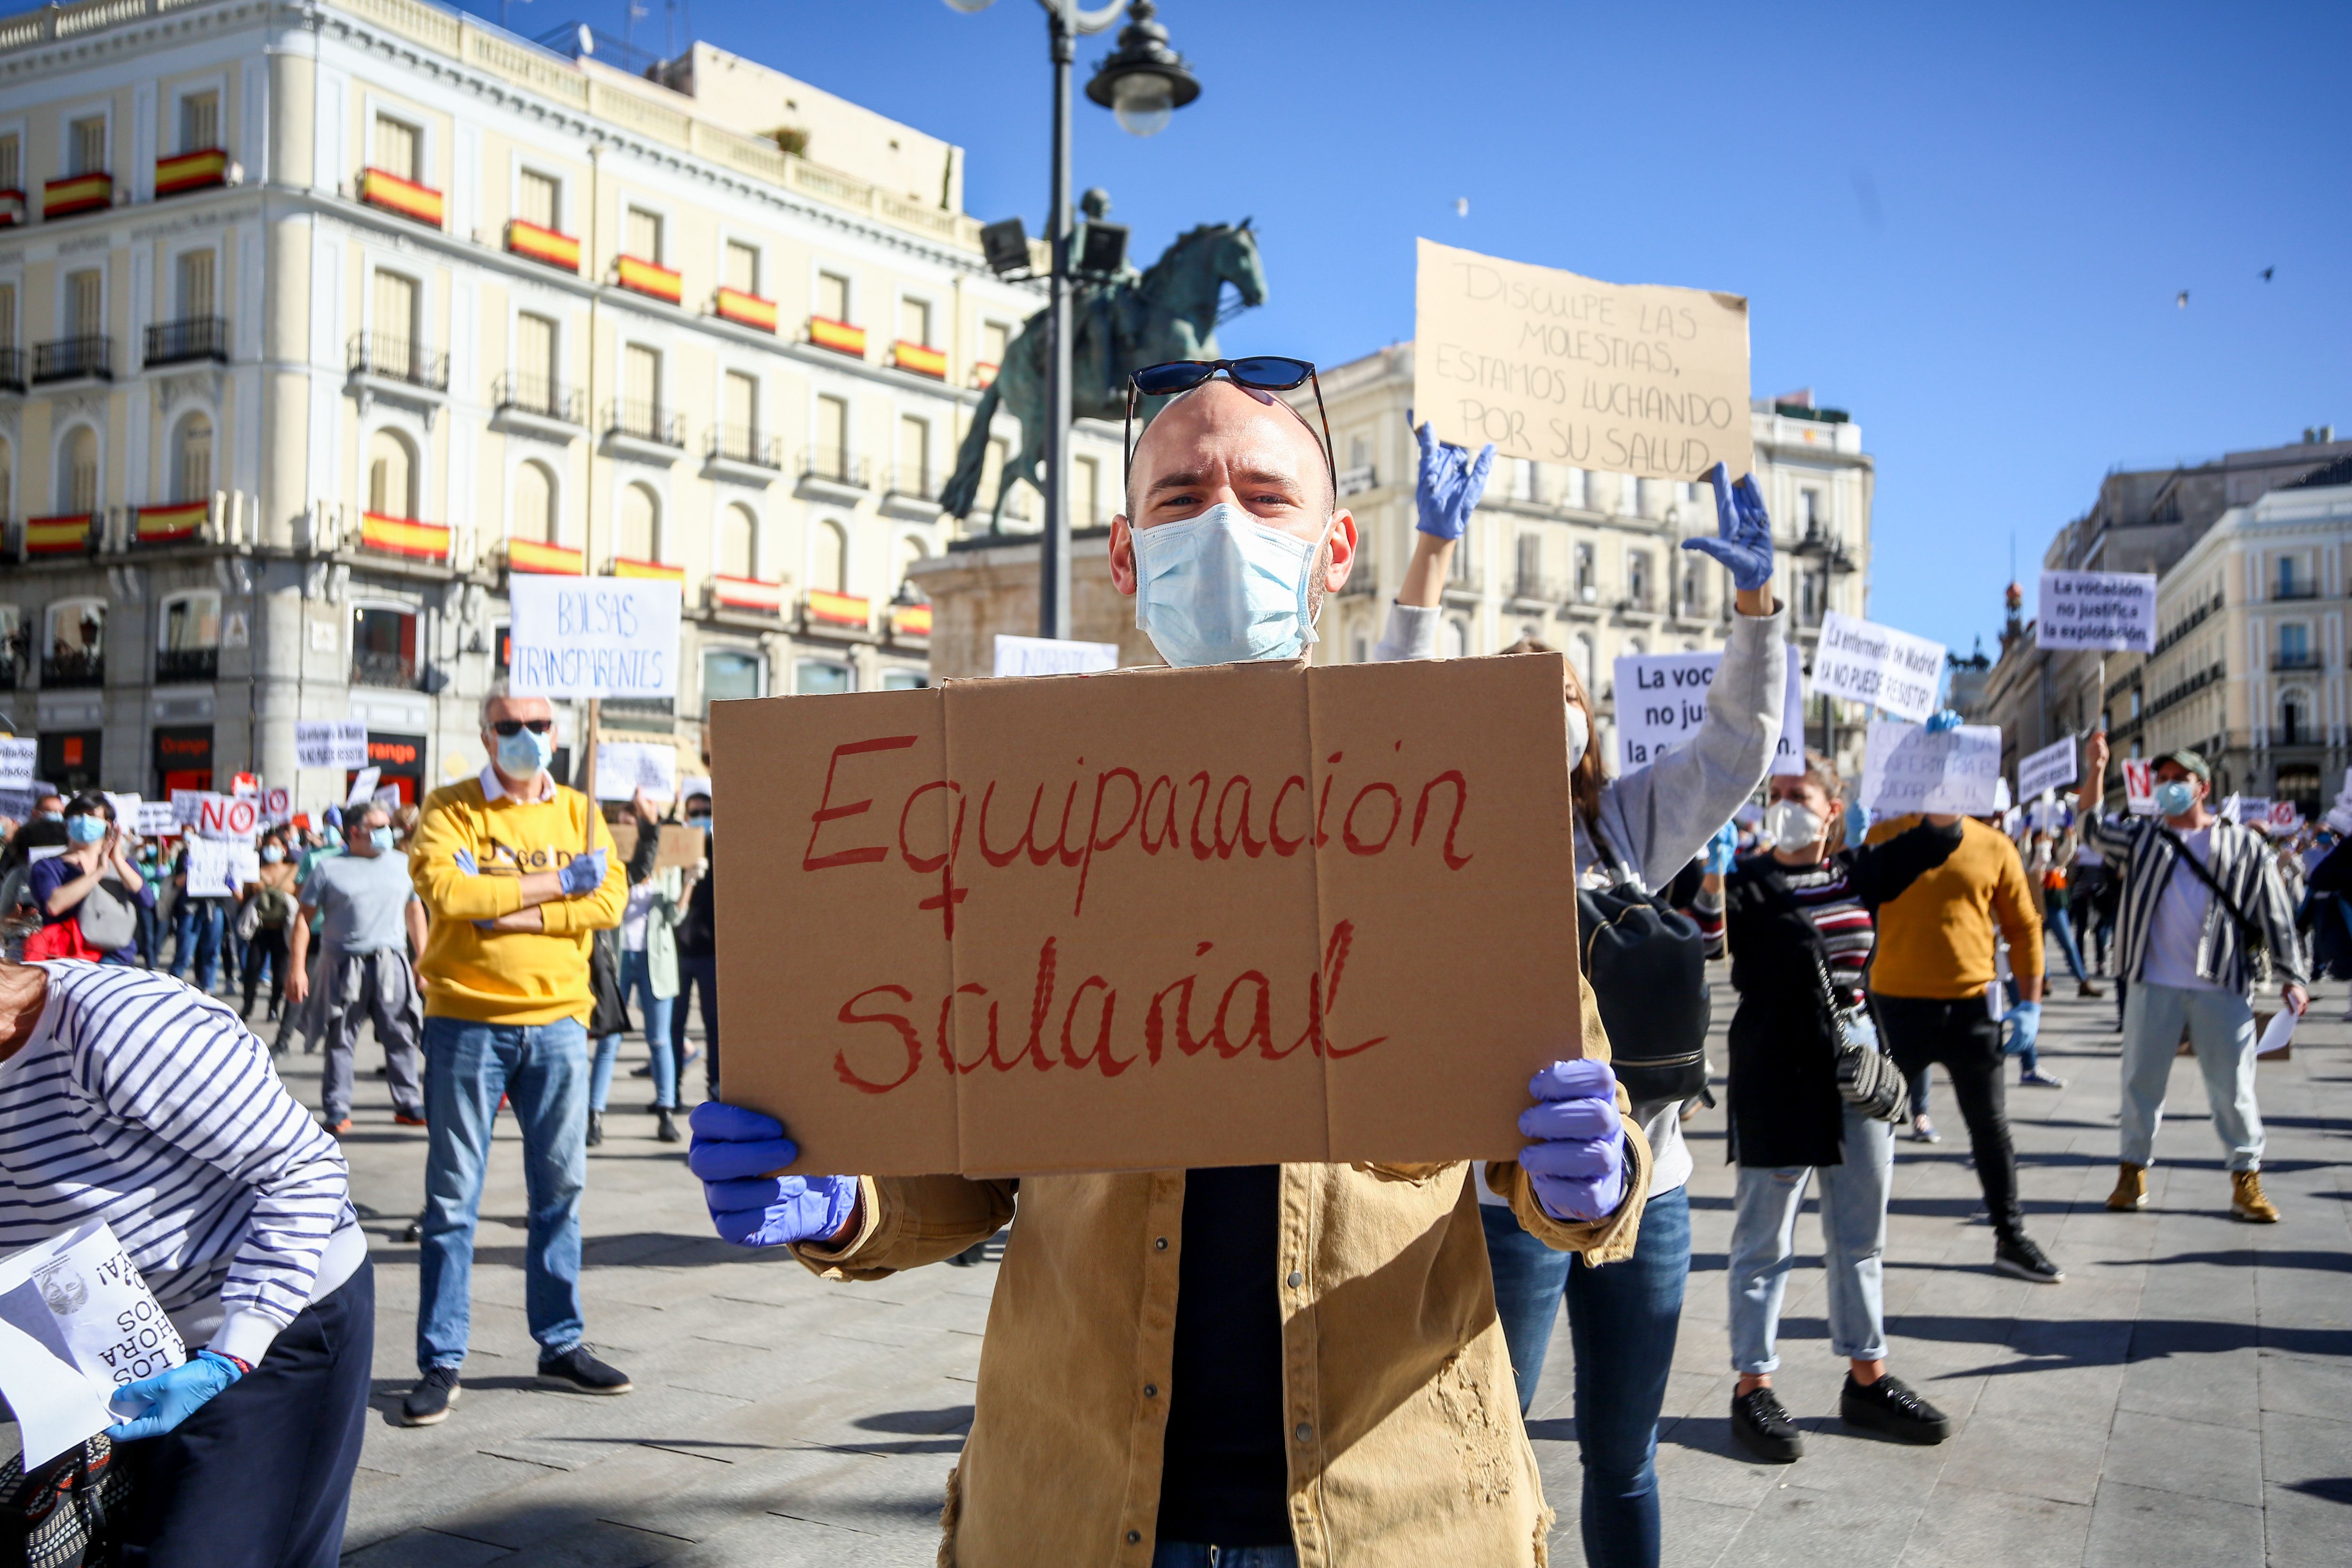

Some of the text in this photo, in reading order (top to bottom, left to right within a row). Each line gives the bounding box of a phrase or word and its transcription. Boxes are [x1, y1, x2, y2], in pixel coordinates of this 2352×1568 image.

[1453, 263, 1697, 340] DISCULPE LAS
[1518, 321, 1680, 376] MOLESTIAS,
[1436, 343, 1732, 430] ESTAMOS LUCHANDO
[1458, 399, 1711, 475] POR SU SALUD
[558, 590, 637, 637] BOLSAS
[516, 645, 664, 690] TRANSPARENTES
[1638, 666, 1664, 689] La
[1646, 707, 1674, 725] no
[368, 742, 416, 764] range
[1628, 740, 1647, 763] la
[201, 798, 255, 834] NO
[802, 734, 1474, 941] Equiparación
[833, 919, 1388, 1095] salarial
[98, 1315, 174, 1367] HORA
[113, 1347, 174, 1388] LOS
